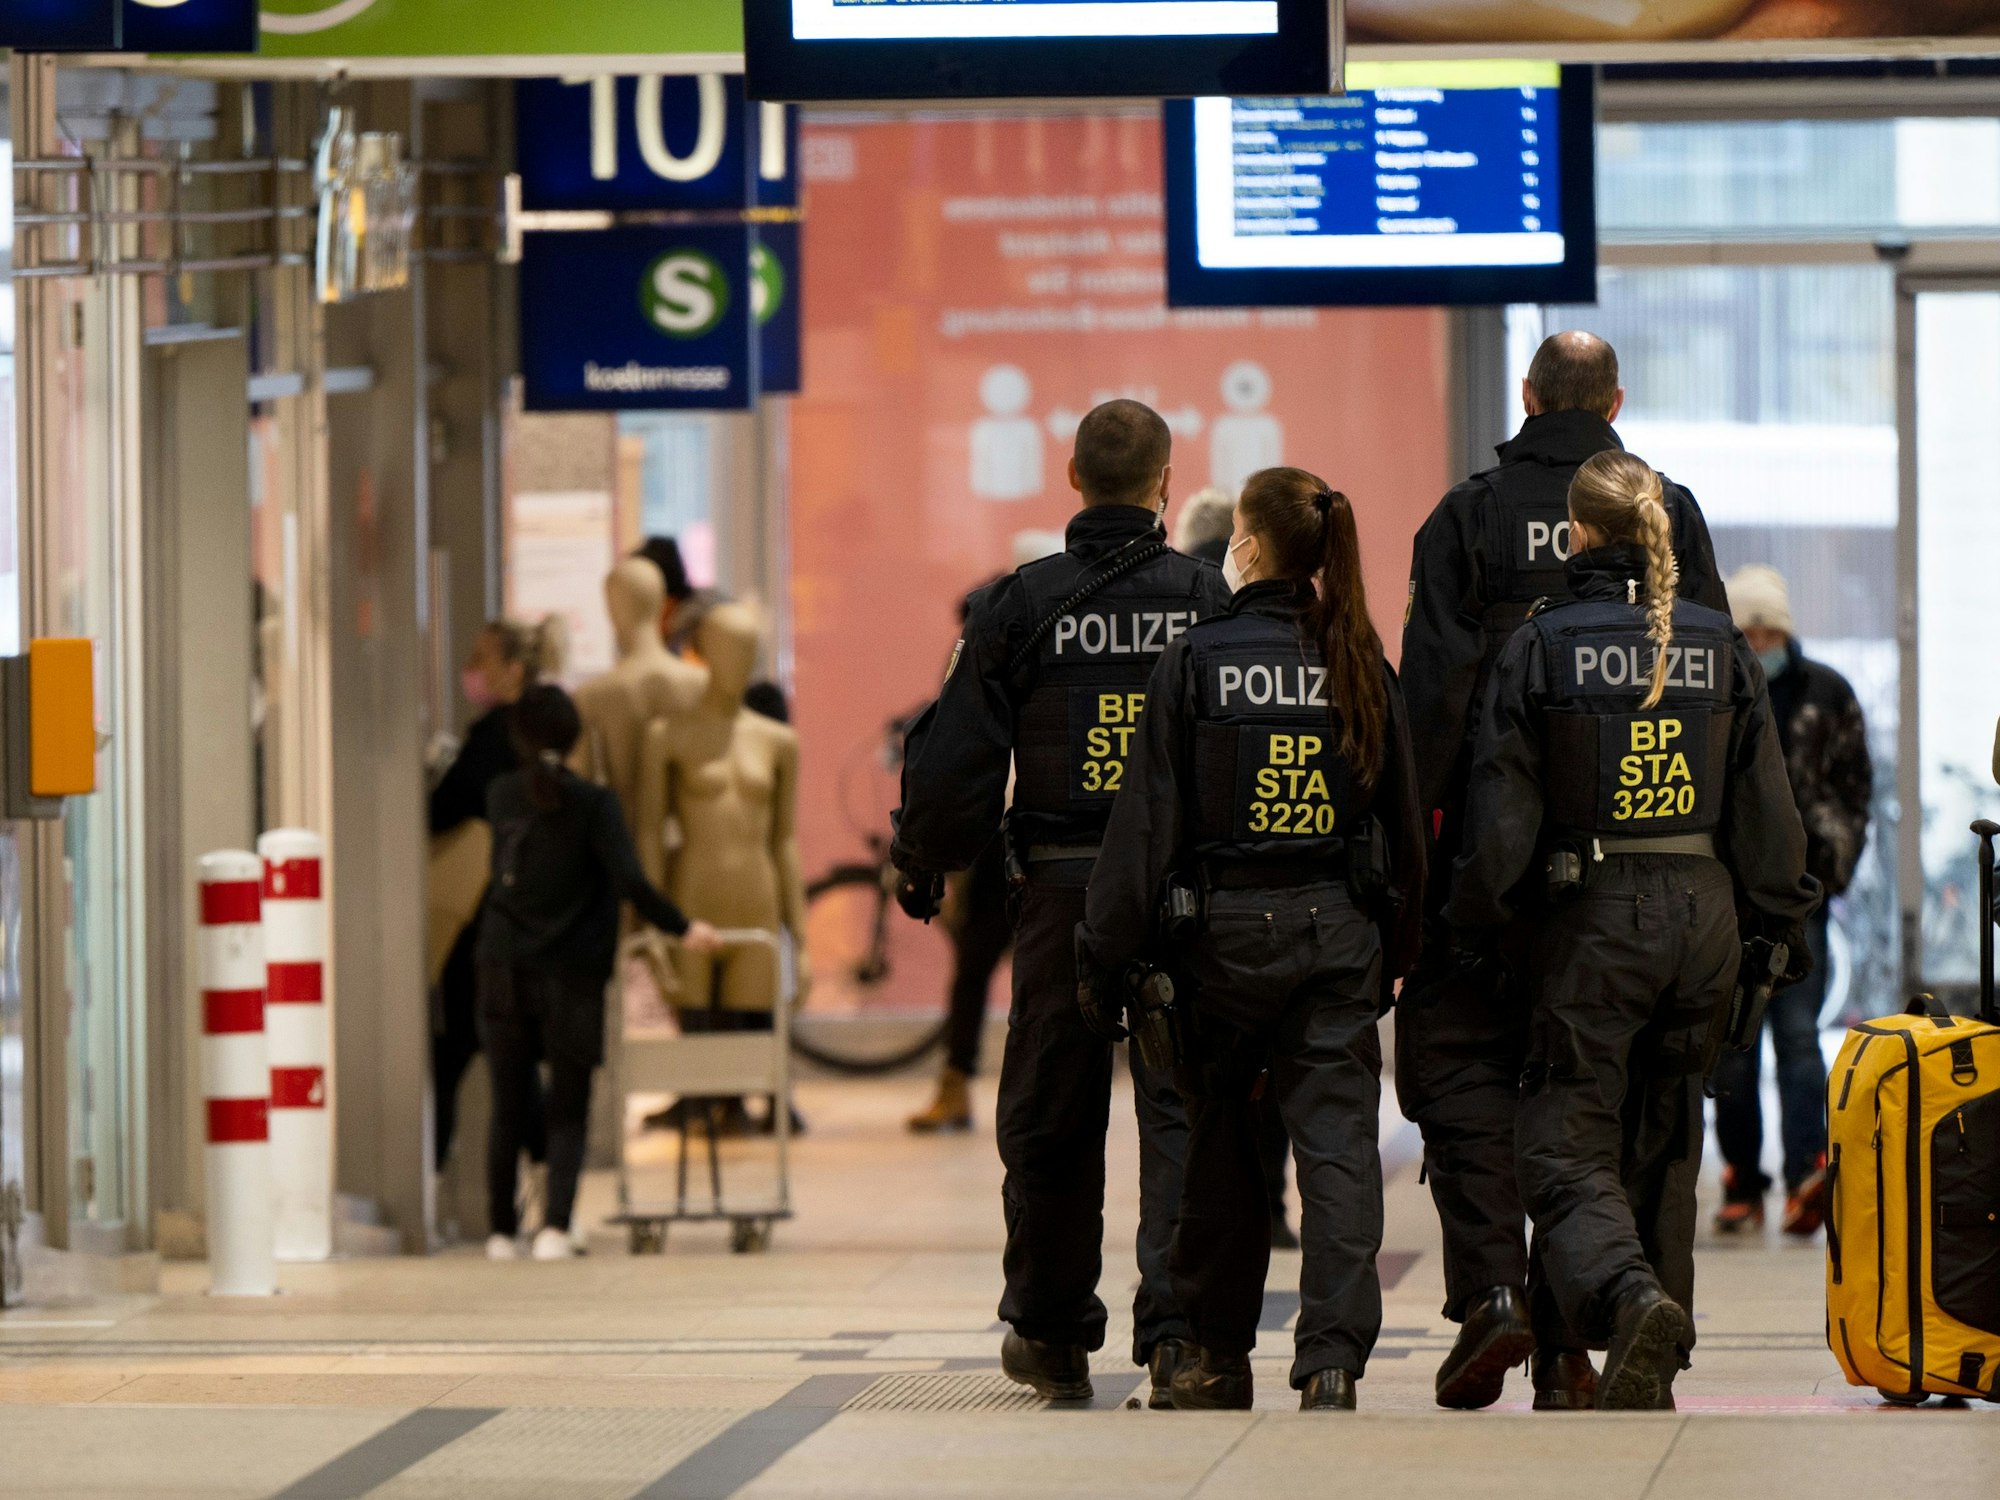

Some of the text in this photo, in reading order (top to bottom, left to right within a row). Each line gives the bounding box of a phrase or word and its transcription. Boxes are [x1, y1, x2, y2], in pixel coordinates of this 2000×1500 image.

[559, 73, 727, 182] 10
[653, 254, 716, 331] S
[1575, 645, 1714, 689] POLIZEI
[1219, 665, 1330, 706] POLIZ
[1087, 727, 1136, 757] ST
[1269, 734, 1322, 766] BP
[1630, 718, 1683, 752] BP
[1082, 760, 1124, 791] 32
[1255, 768, 1330, 800] STA
[1618, 752, 1692, 787] STA
[1248, 802, 1335, 835] 3220
[1612, 784, 1696, 820] 3220
